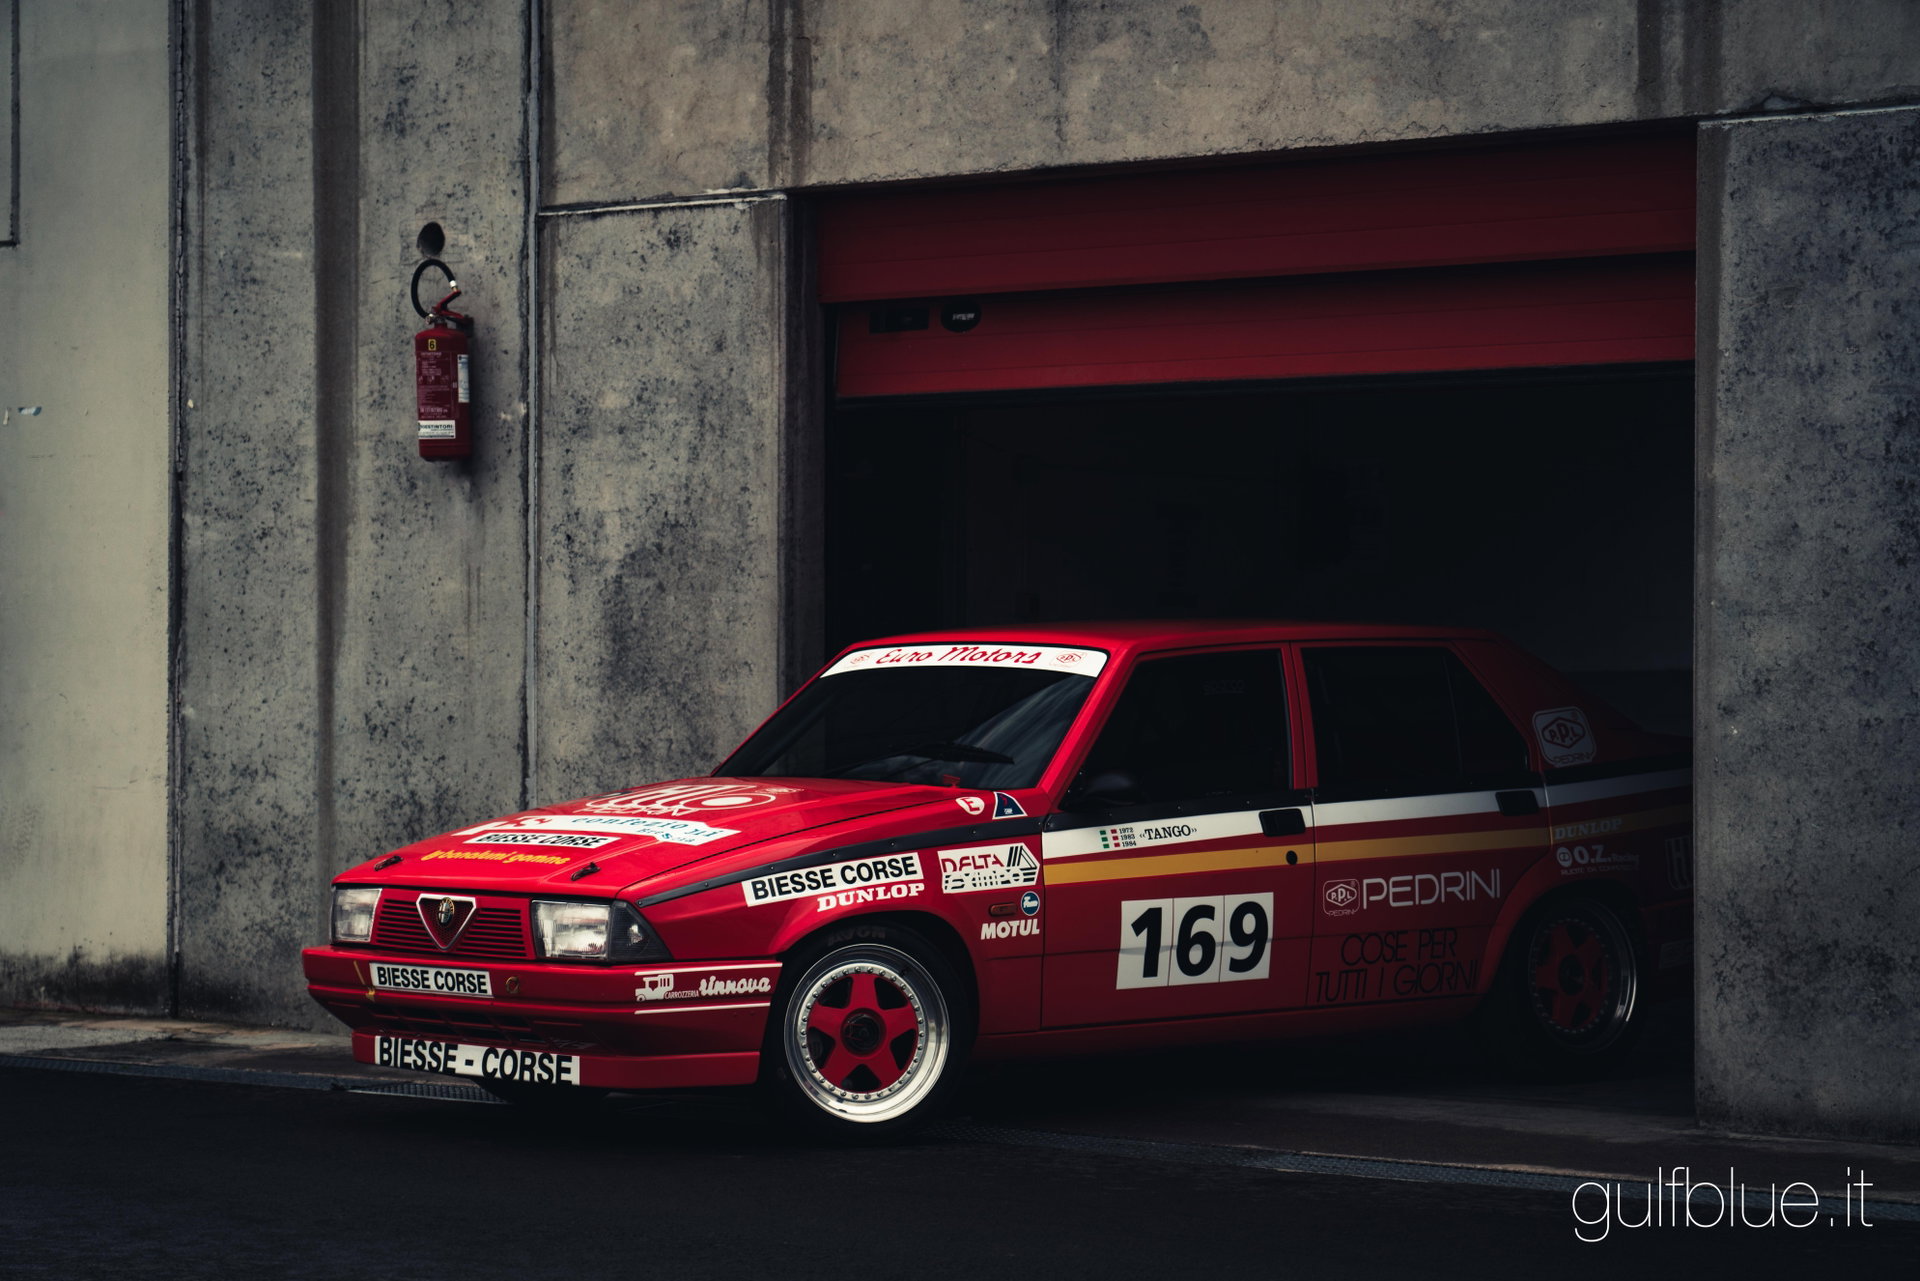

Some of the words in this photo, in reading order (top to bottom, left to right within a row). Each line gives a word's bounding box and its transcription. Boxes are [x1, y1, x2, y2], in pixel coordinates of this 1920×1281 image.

[429, 341, 435, 349] 6
[876, 649, 933, 664] Euro
[938, 646, 1042, 664] Motors
[476, 832, 539, 843] BIESSE
[542, 835, 609, 847] CORSE
[1554, 818, 1622, 840] DUNLOP
[502, 854, 571, 865] gomme
[941, 854, 1005, 873] DELTA
[751, 867, 836, 901] BIESSE
[840, 855, 918, 885] CORSE
[1363, 868, 1500, 909] PEDRINI
[817, 882, 925, 913] DUNLOP
[980, 919, 1041, 941] MOTUL
[1130, 901, 1269, 979] 169
[1341, 931, 1408, 966] COSE
[1416, 927, 1458, 962] PER
[376, 966, 431, 990] BIESSE
[434, 971, 488, 994] CORSE
[664, 989, 700, 1000] CARROZZERIA
[699, 975, 772, 997] rinnova
[1316, 968, 1369, 1002] TUTTI
[1377, 967, 1385, 998] I
[1393, 959, 1479, 995] GIORNI
[378, 1034, 458, 1074] BIESSE
[481, 1047, 572, 1085] CORSE
